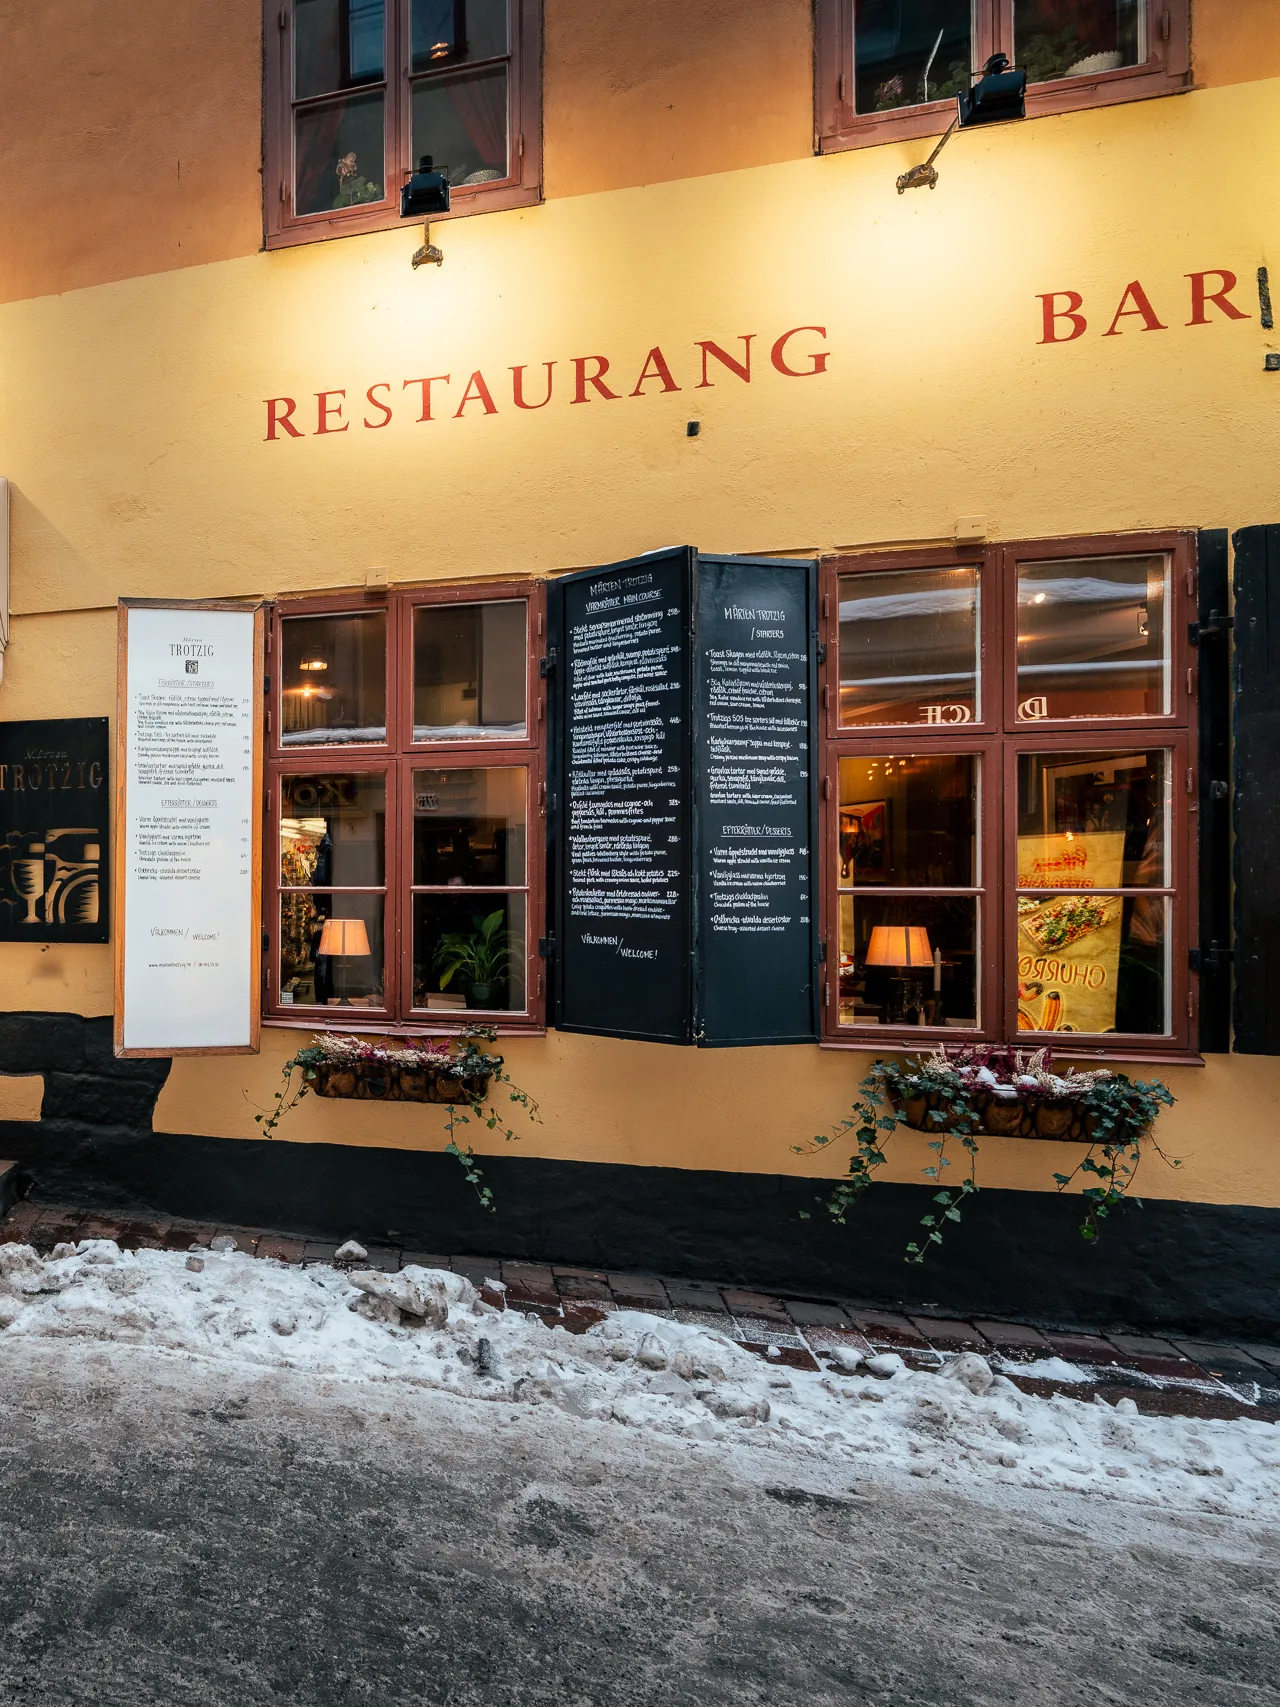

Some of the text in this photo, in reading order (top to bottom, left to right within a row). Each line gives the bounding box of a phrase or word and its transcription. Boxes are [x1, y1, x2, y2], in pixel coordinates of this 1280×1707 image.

[1034, 268, 1253, 346] BAR
[261, 324, 831, 442] RESTAURANG
[590, 574, 653, 597] MÅRTEN TROTZIG
[724, 604, 786, 621] MÅRTEN TROTZIG
[574, 624, 588, 635] Stekt
[639, 621, 658, 629] lingon
[756, 630, 784, 639] STARTERS
[169, 644, 214, 657] TROTZIG
[709, 649, 725, 658] Toast
[726, 650, 745, 661] Skagen
[709, 713, 731, 726] Trotzigs
[713, 847, 728, 856] Varm
[713, 892, 734, 903] Trotzigs
[150, 927, 183, 936] VÄLKOMMEN
[192, 932, 220, 941] WELCOME!
[581, 933, 618, 946] VÄLKOMMEN
[621, 948, 658, 960] WELCOME!
